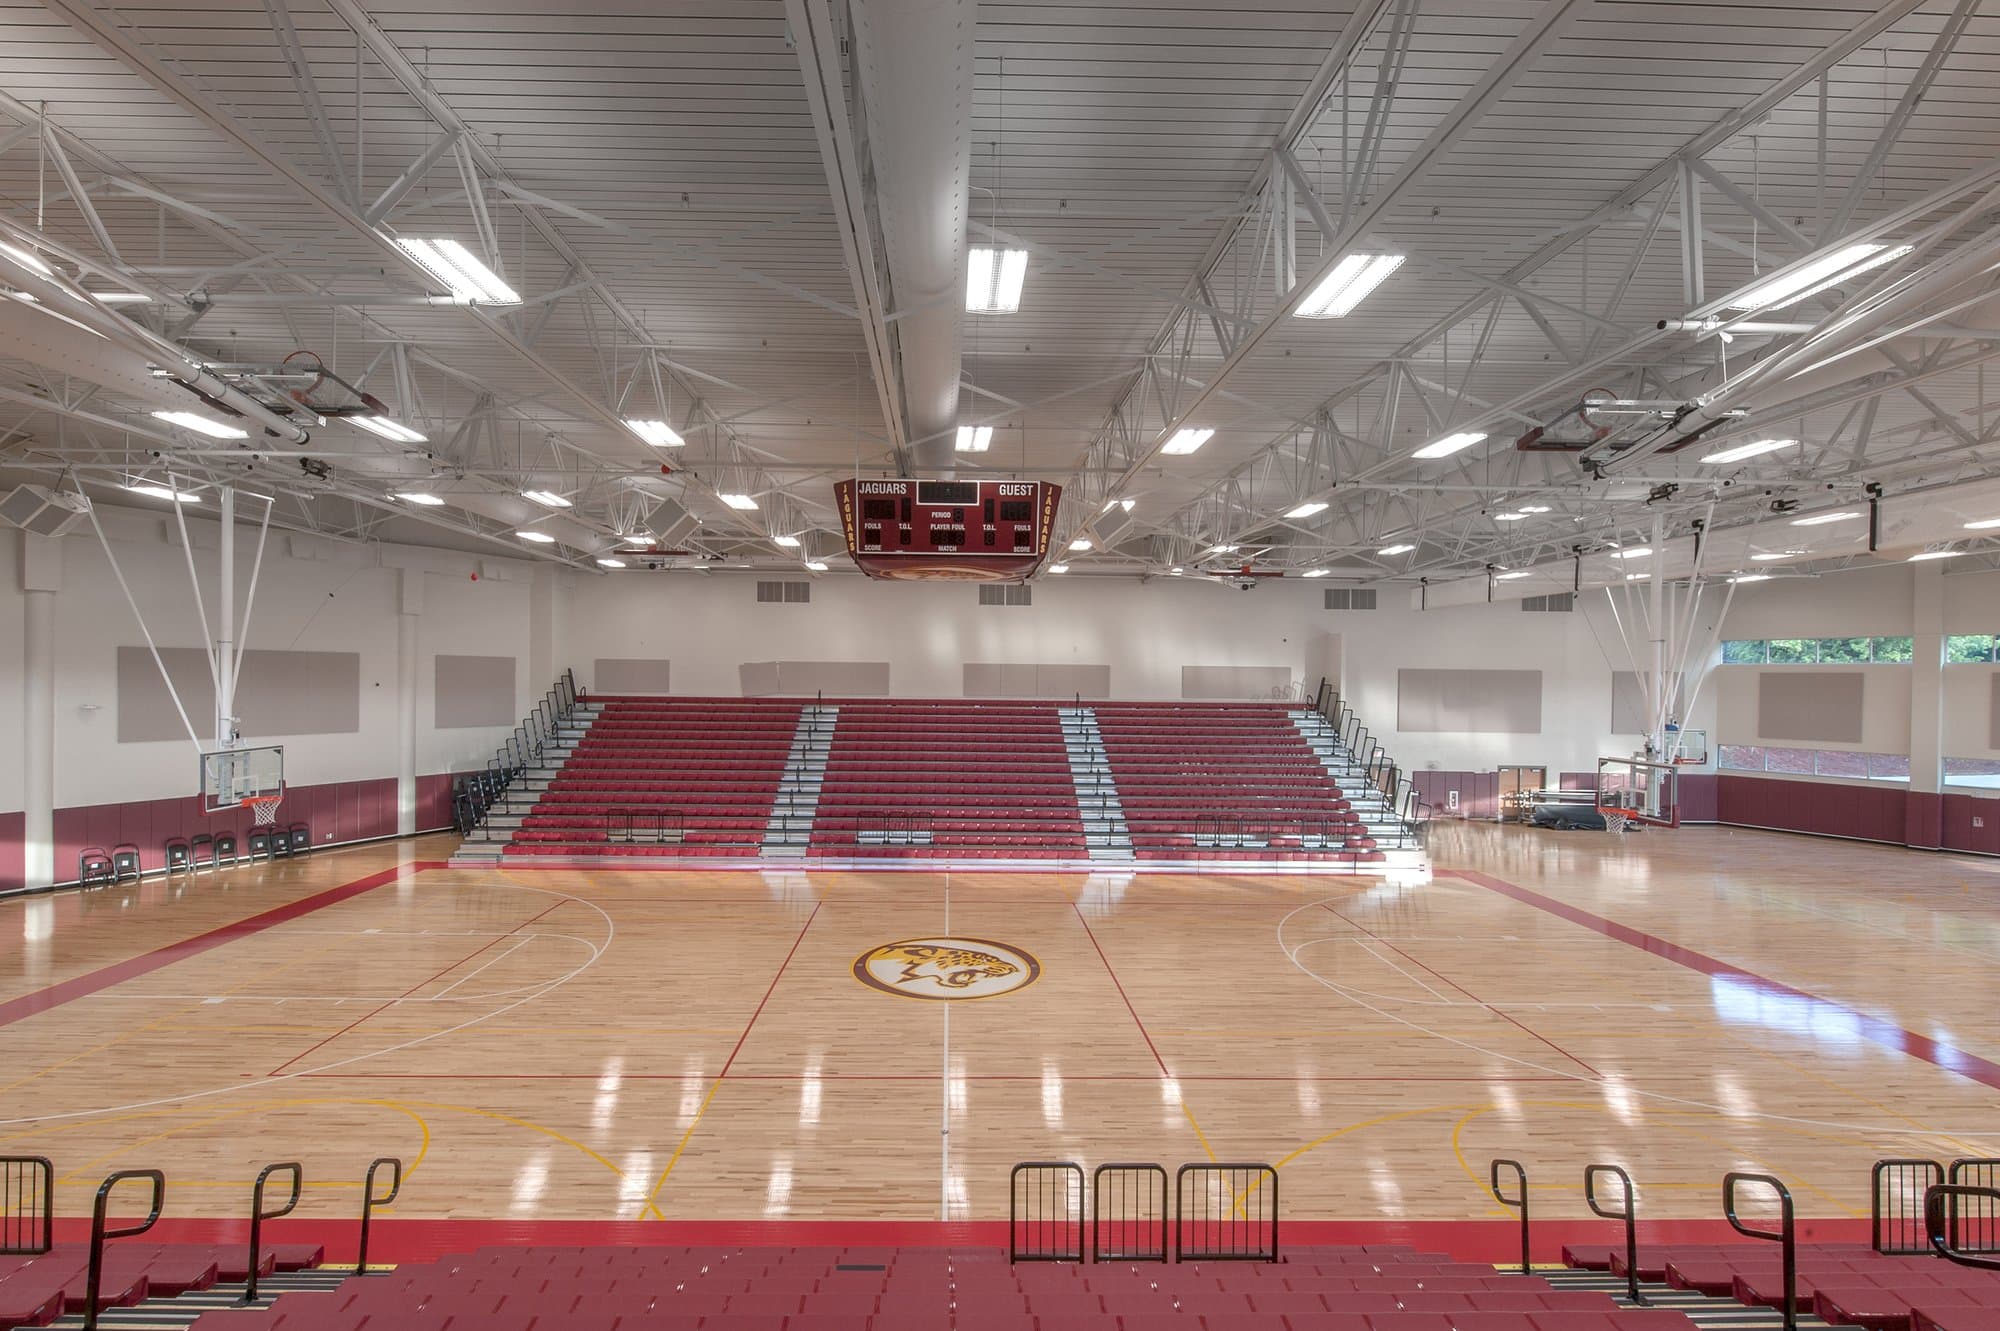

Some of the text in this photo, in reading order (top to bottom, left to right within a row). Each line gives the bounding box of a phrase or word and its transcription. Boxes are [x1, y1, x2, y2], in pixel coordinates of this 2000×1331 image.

[859, 483, 907, 494] JAGUARS
[999, 484, 1033, 496] GUEST
[843, 483, 855, 552] JAGUARS
[1040, 487, 1053, 553] JAGUARS
